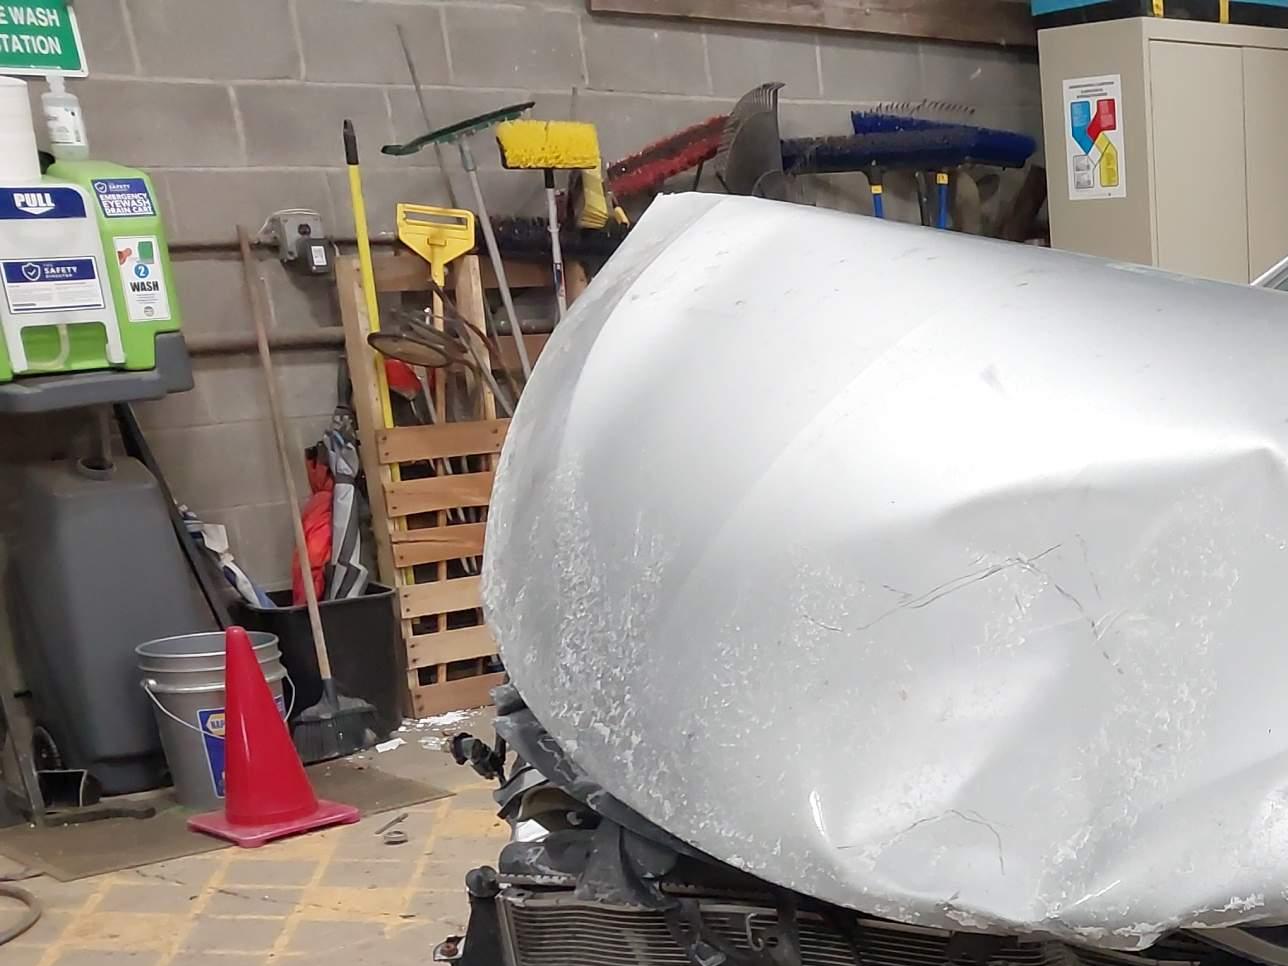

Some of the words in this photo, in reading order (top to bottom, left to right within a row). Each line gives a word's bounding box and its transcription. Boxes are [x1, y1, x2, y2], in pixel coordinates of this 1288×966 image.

[0, 33, 62, 54] TATION
[13, 192, 55, 207] PULL
[103, 199, 152, 208] EYEWASH
[44, 266, 77, 274] SAFETY
[138, 265, 147, 277] 2
[130, 281, 160, 292] WASH
